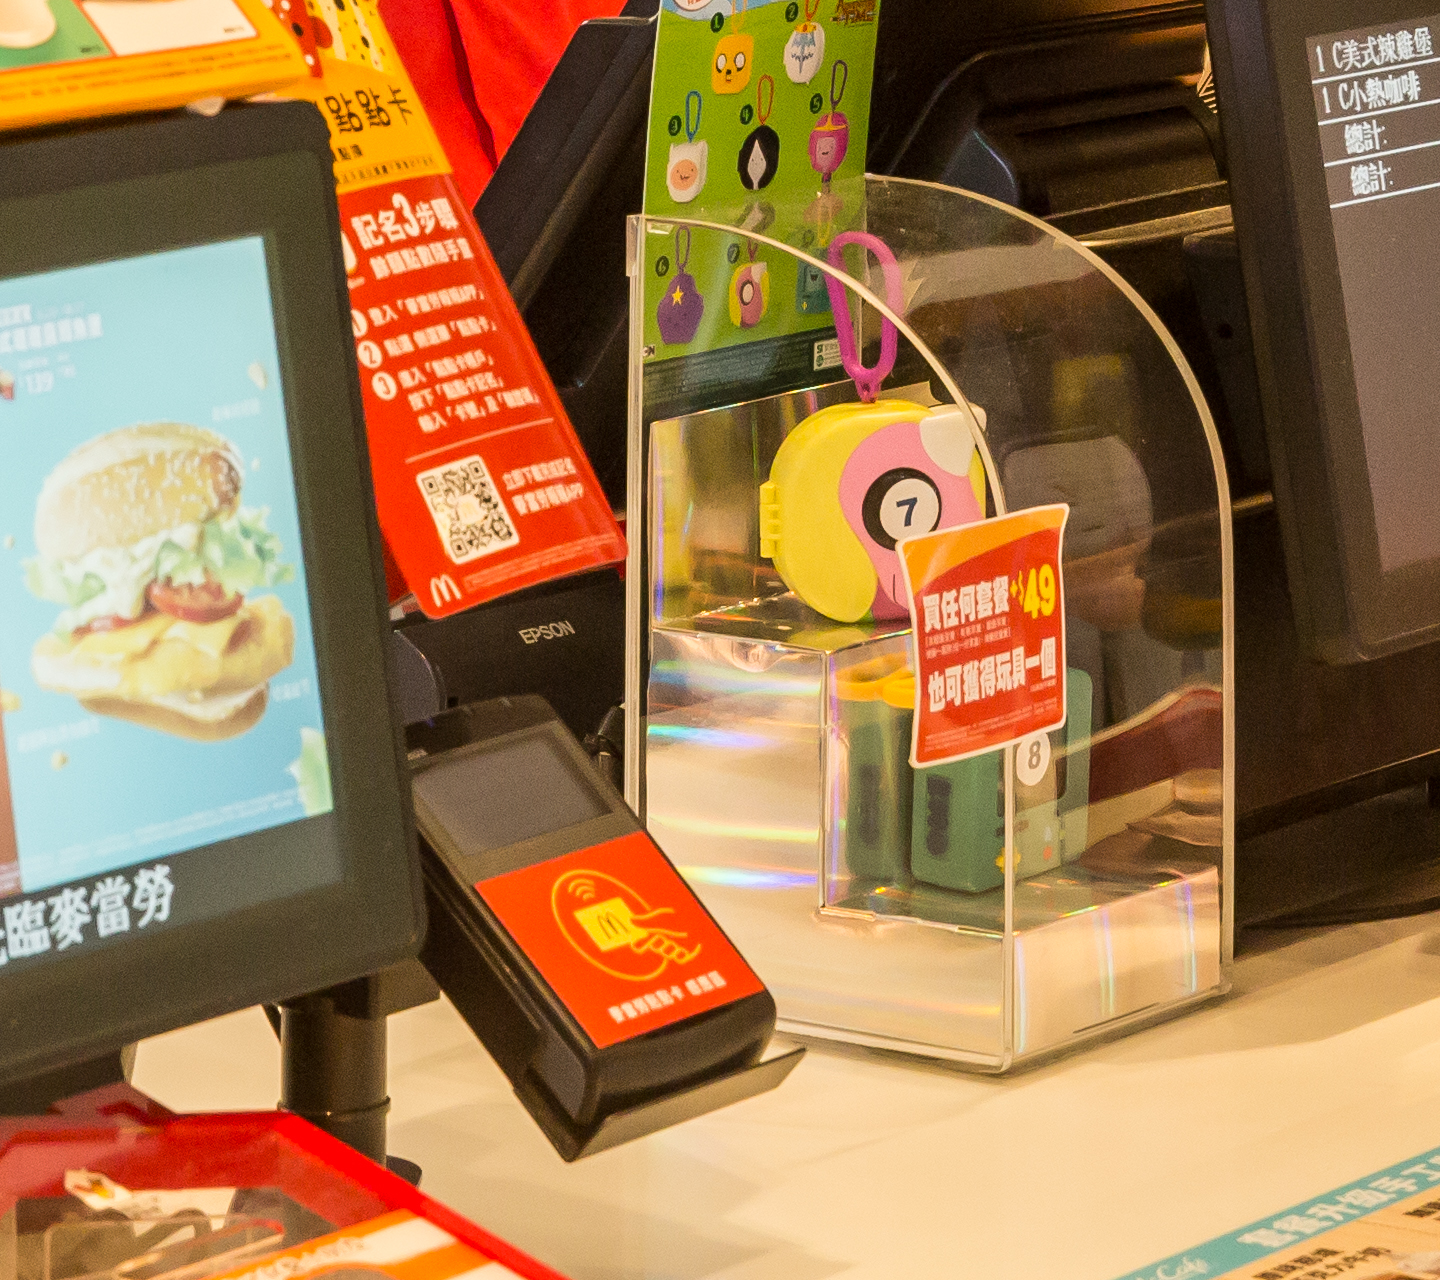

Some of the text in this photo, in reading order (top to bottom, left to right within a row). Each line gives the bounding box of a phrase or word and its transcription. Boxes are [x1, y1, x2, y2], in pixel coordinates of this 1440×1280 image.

[1316, 47, 1324, 71] 1
[1333, 26, 1434, 70] C美式辣雞堡
[1323, 88, 1330, 113] 1
[1339, 70, 1421, 111] C小熱咖啡
[351, 192, 459, 251] 記名3步驟
[896, 496, 918, 527] 7
[923, 575, 1009, 634] 買任何套餐
[518, 620, 576, 645] EPSON
[928, 637, 1056, 713] 也可獲得玩具一個
[1027, 740, 1042, 770] 8
